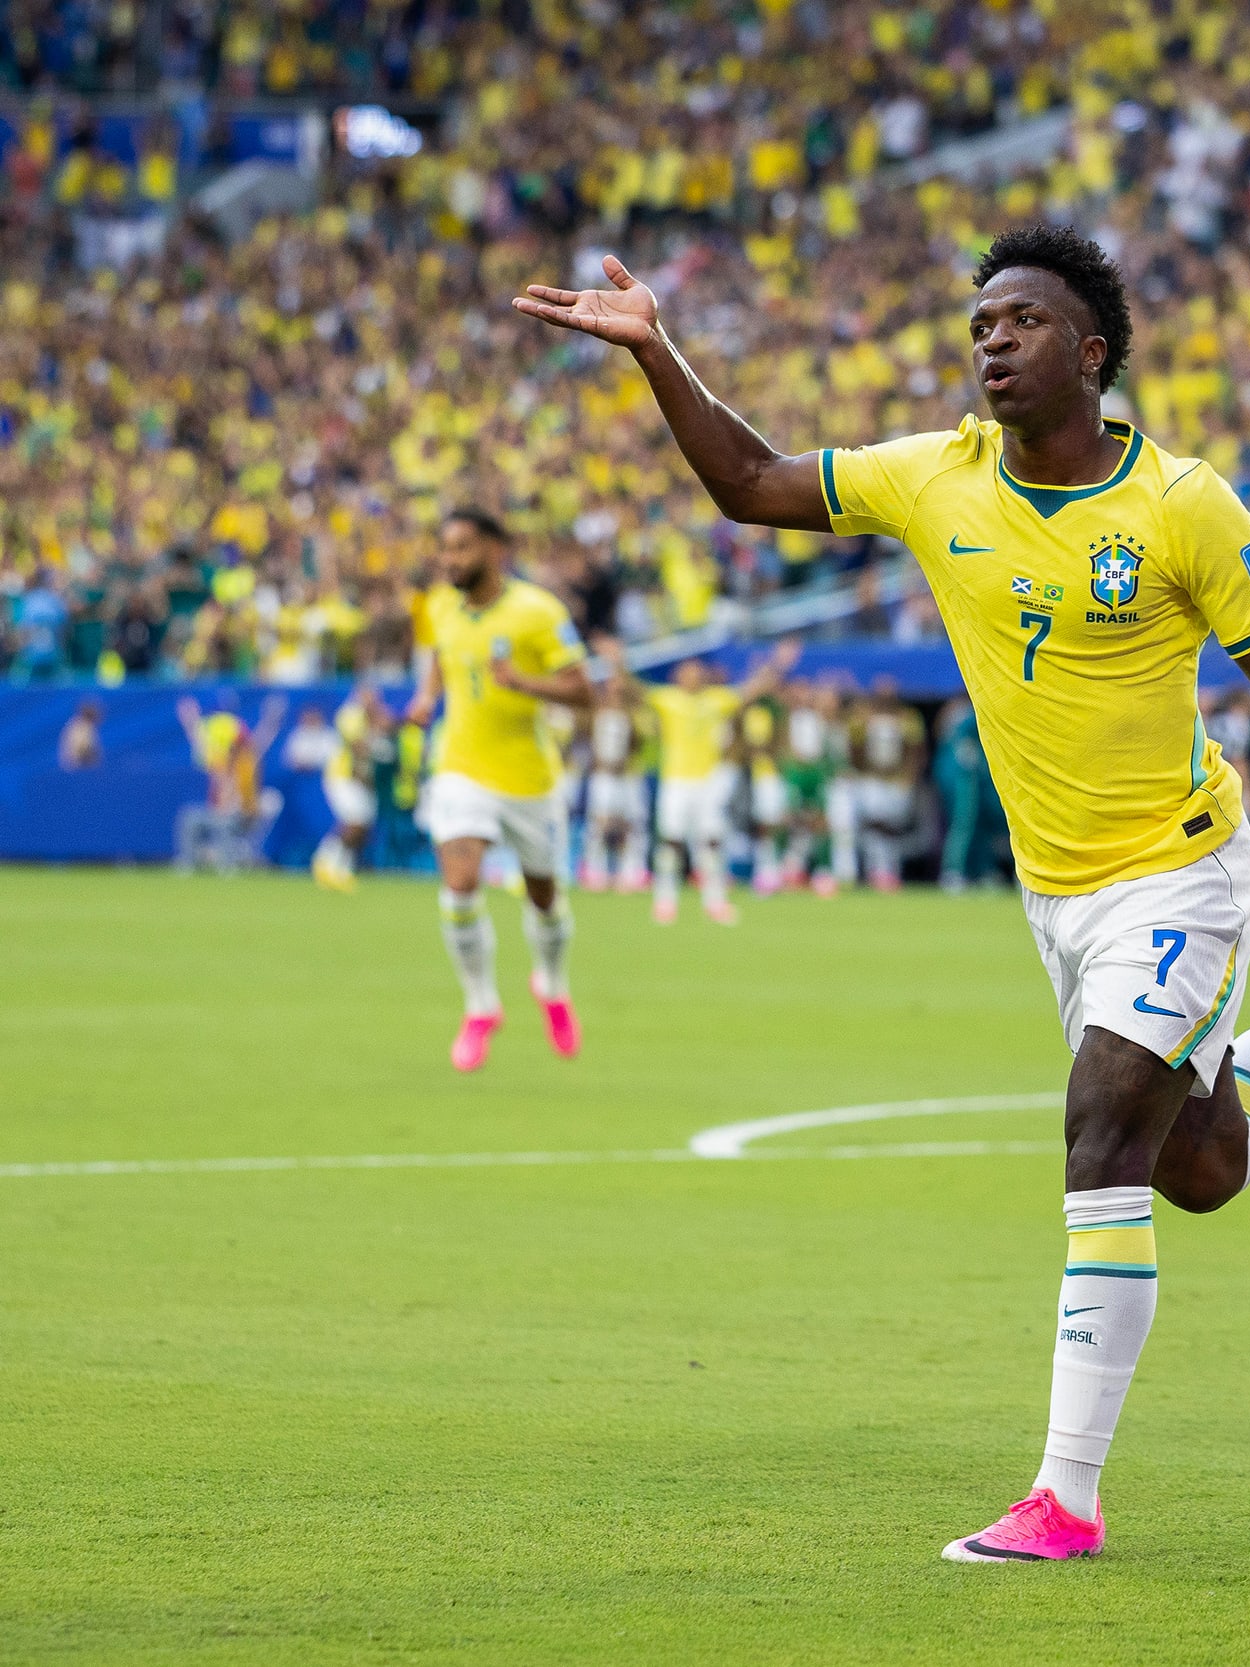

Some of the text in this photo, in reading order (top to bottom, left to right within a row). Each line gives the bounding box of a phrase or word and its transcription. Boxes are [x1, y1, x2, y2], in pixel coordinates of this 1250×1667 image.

[1105, 570, 1125, 579] CBF
[1086, 611, 1140, 623] BRASIL
[1020, 611, 1052, 681] 7
[1152, 929, 1186, 987] 7
[1061, 1328, 1098, 1346] BRASIL
